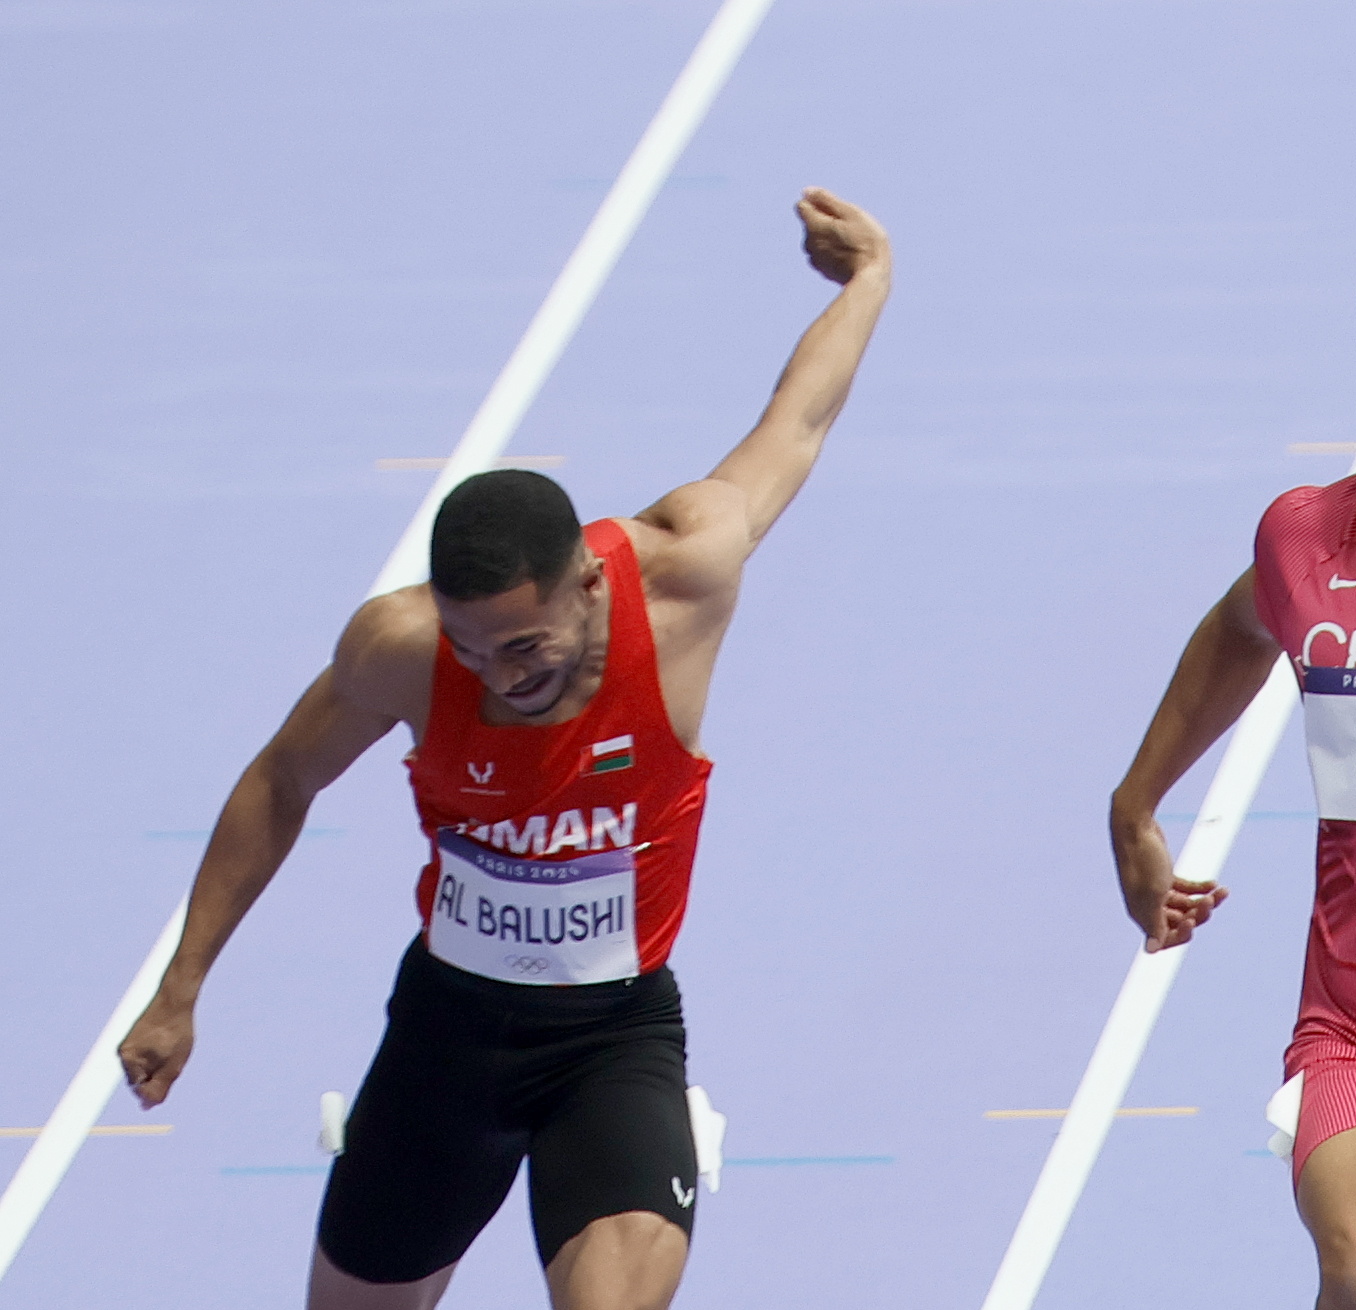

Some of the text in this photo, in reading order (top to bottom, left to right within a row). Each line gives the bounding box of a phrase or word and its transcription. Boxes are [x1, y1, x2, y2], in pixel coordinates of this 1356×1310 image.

[476, 854, 580, 880] PARIS 2024
[437, 874, 625, 945] AL BALUSHI
